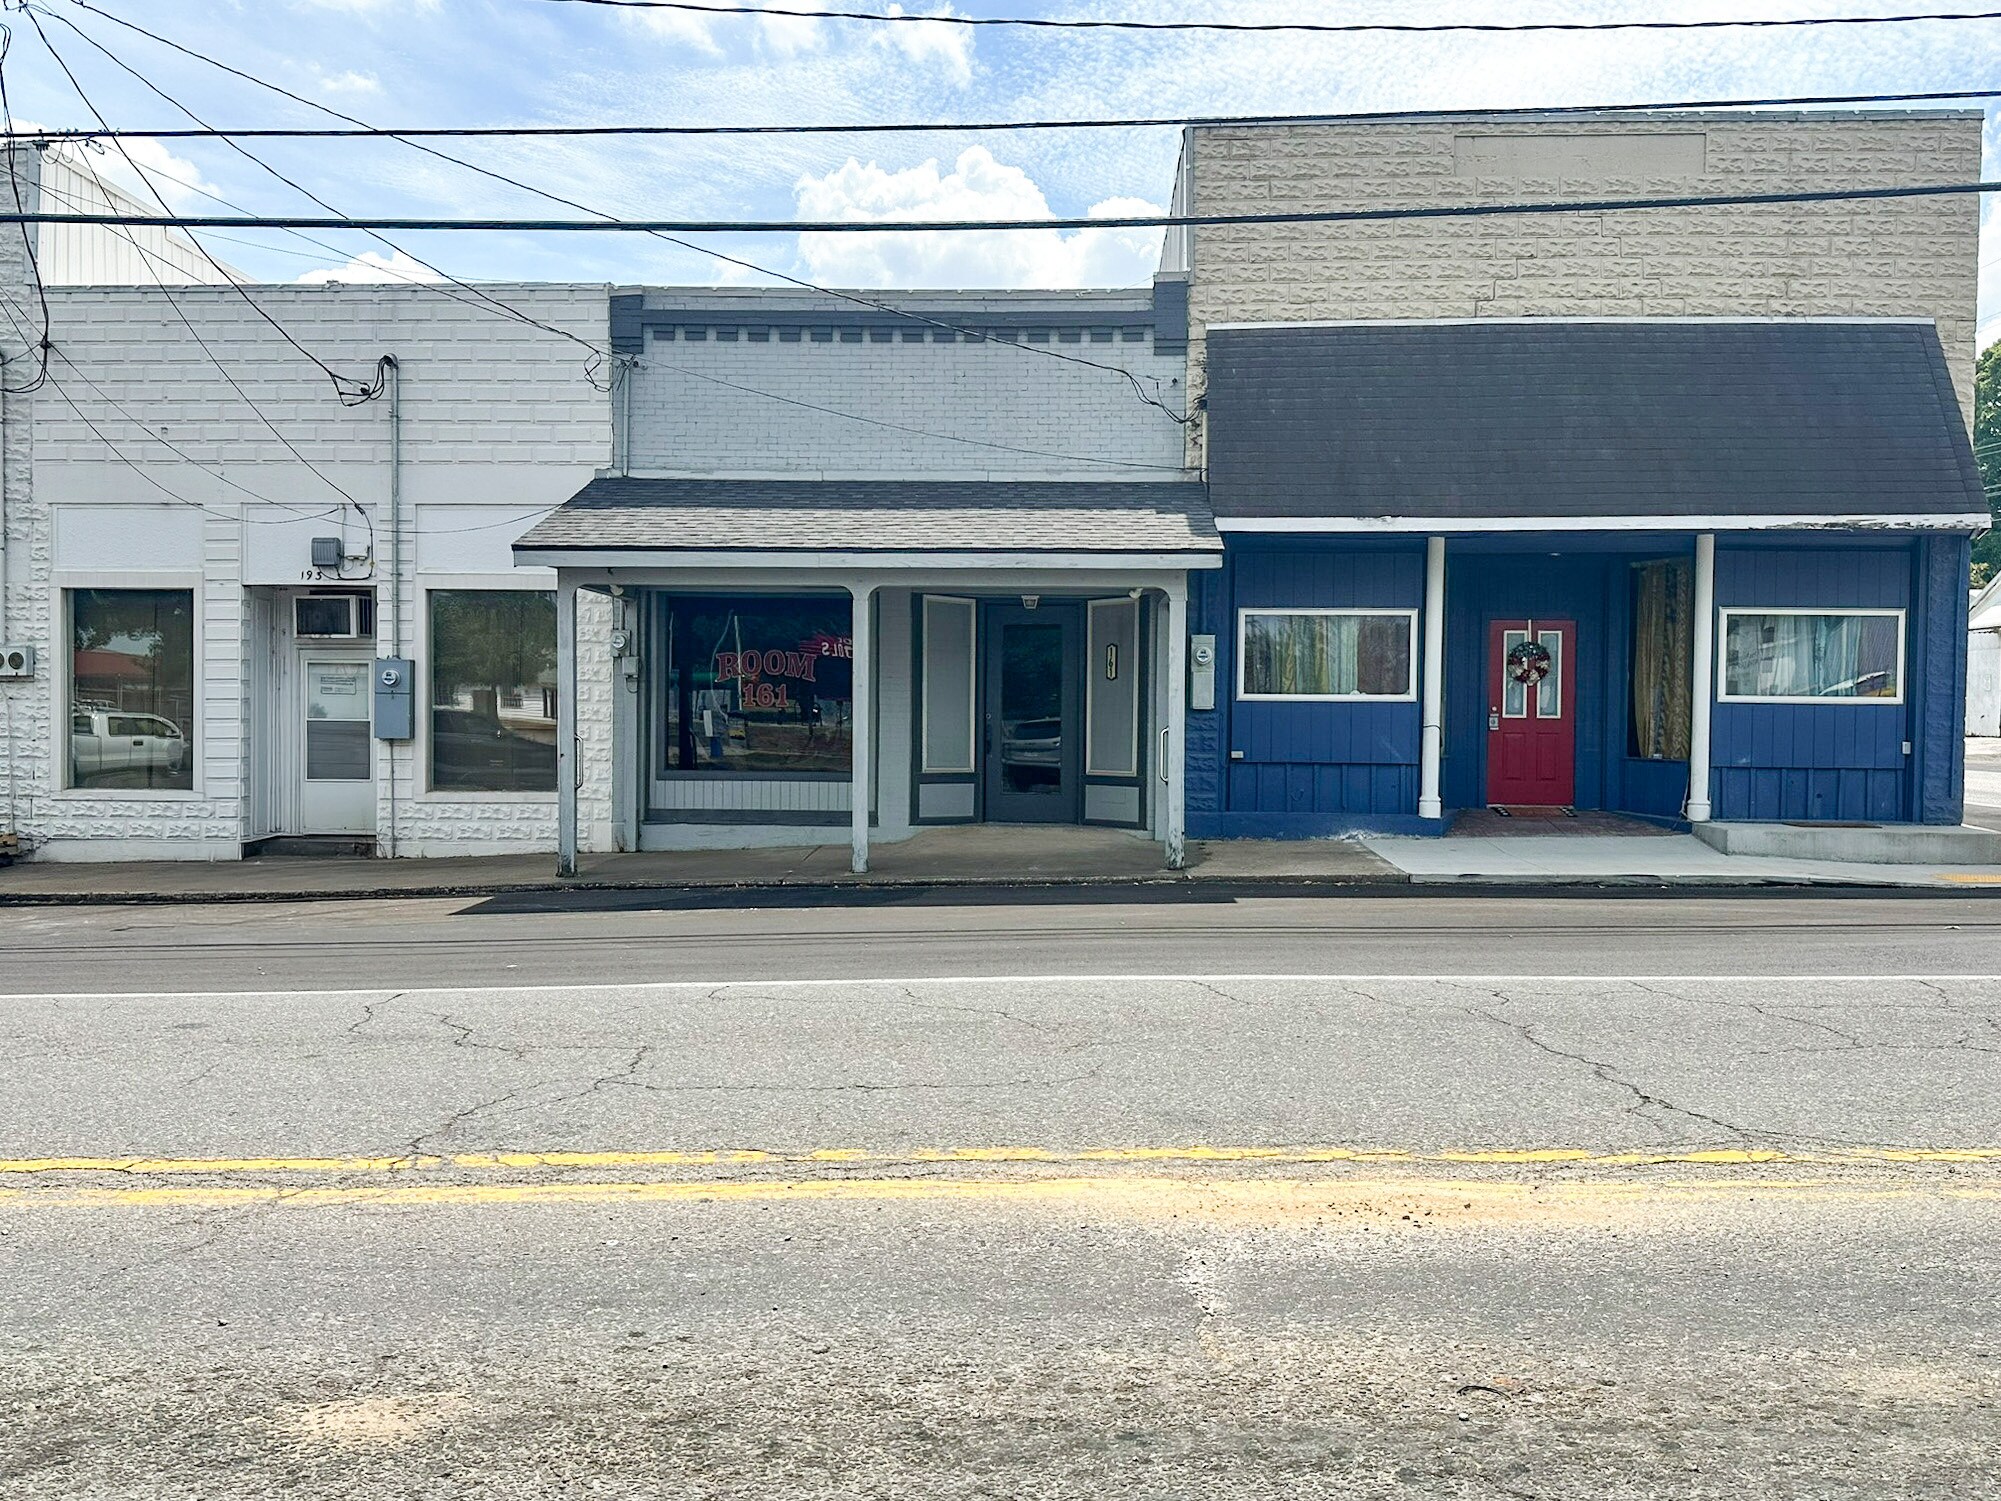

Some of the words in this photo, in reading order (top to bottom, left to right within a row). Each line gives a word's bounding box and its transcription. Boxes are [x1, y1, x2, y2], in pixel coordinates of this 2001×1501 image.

[301, 570, 322, 581] 193
[715, 649, 817, 682] ROOM
[742, 683, 790, 707] 161
